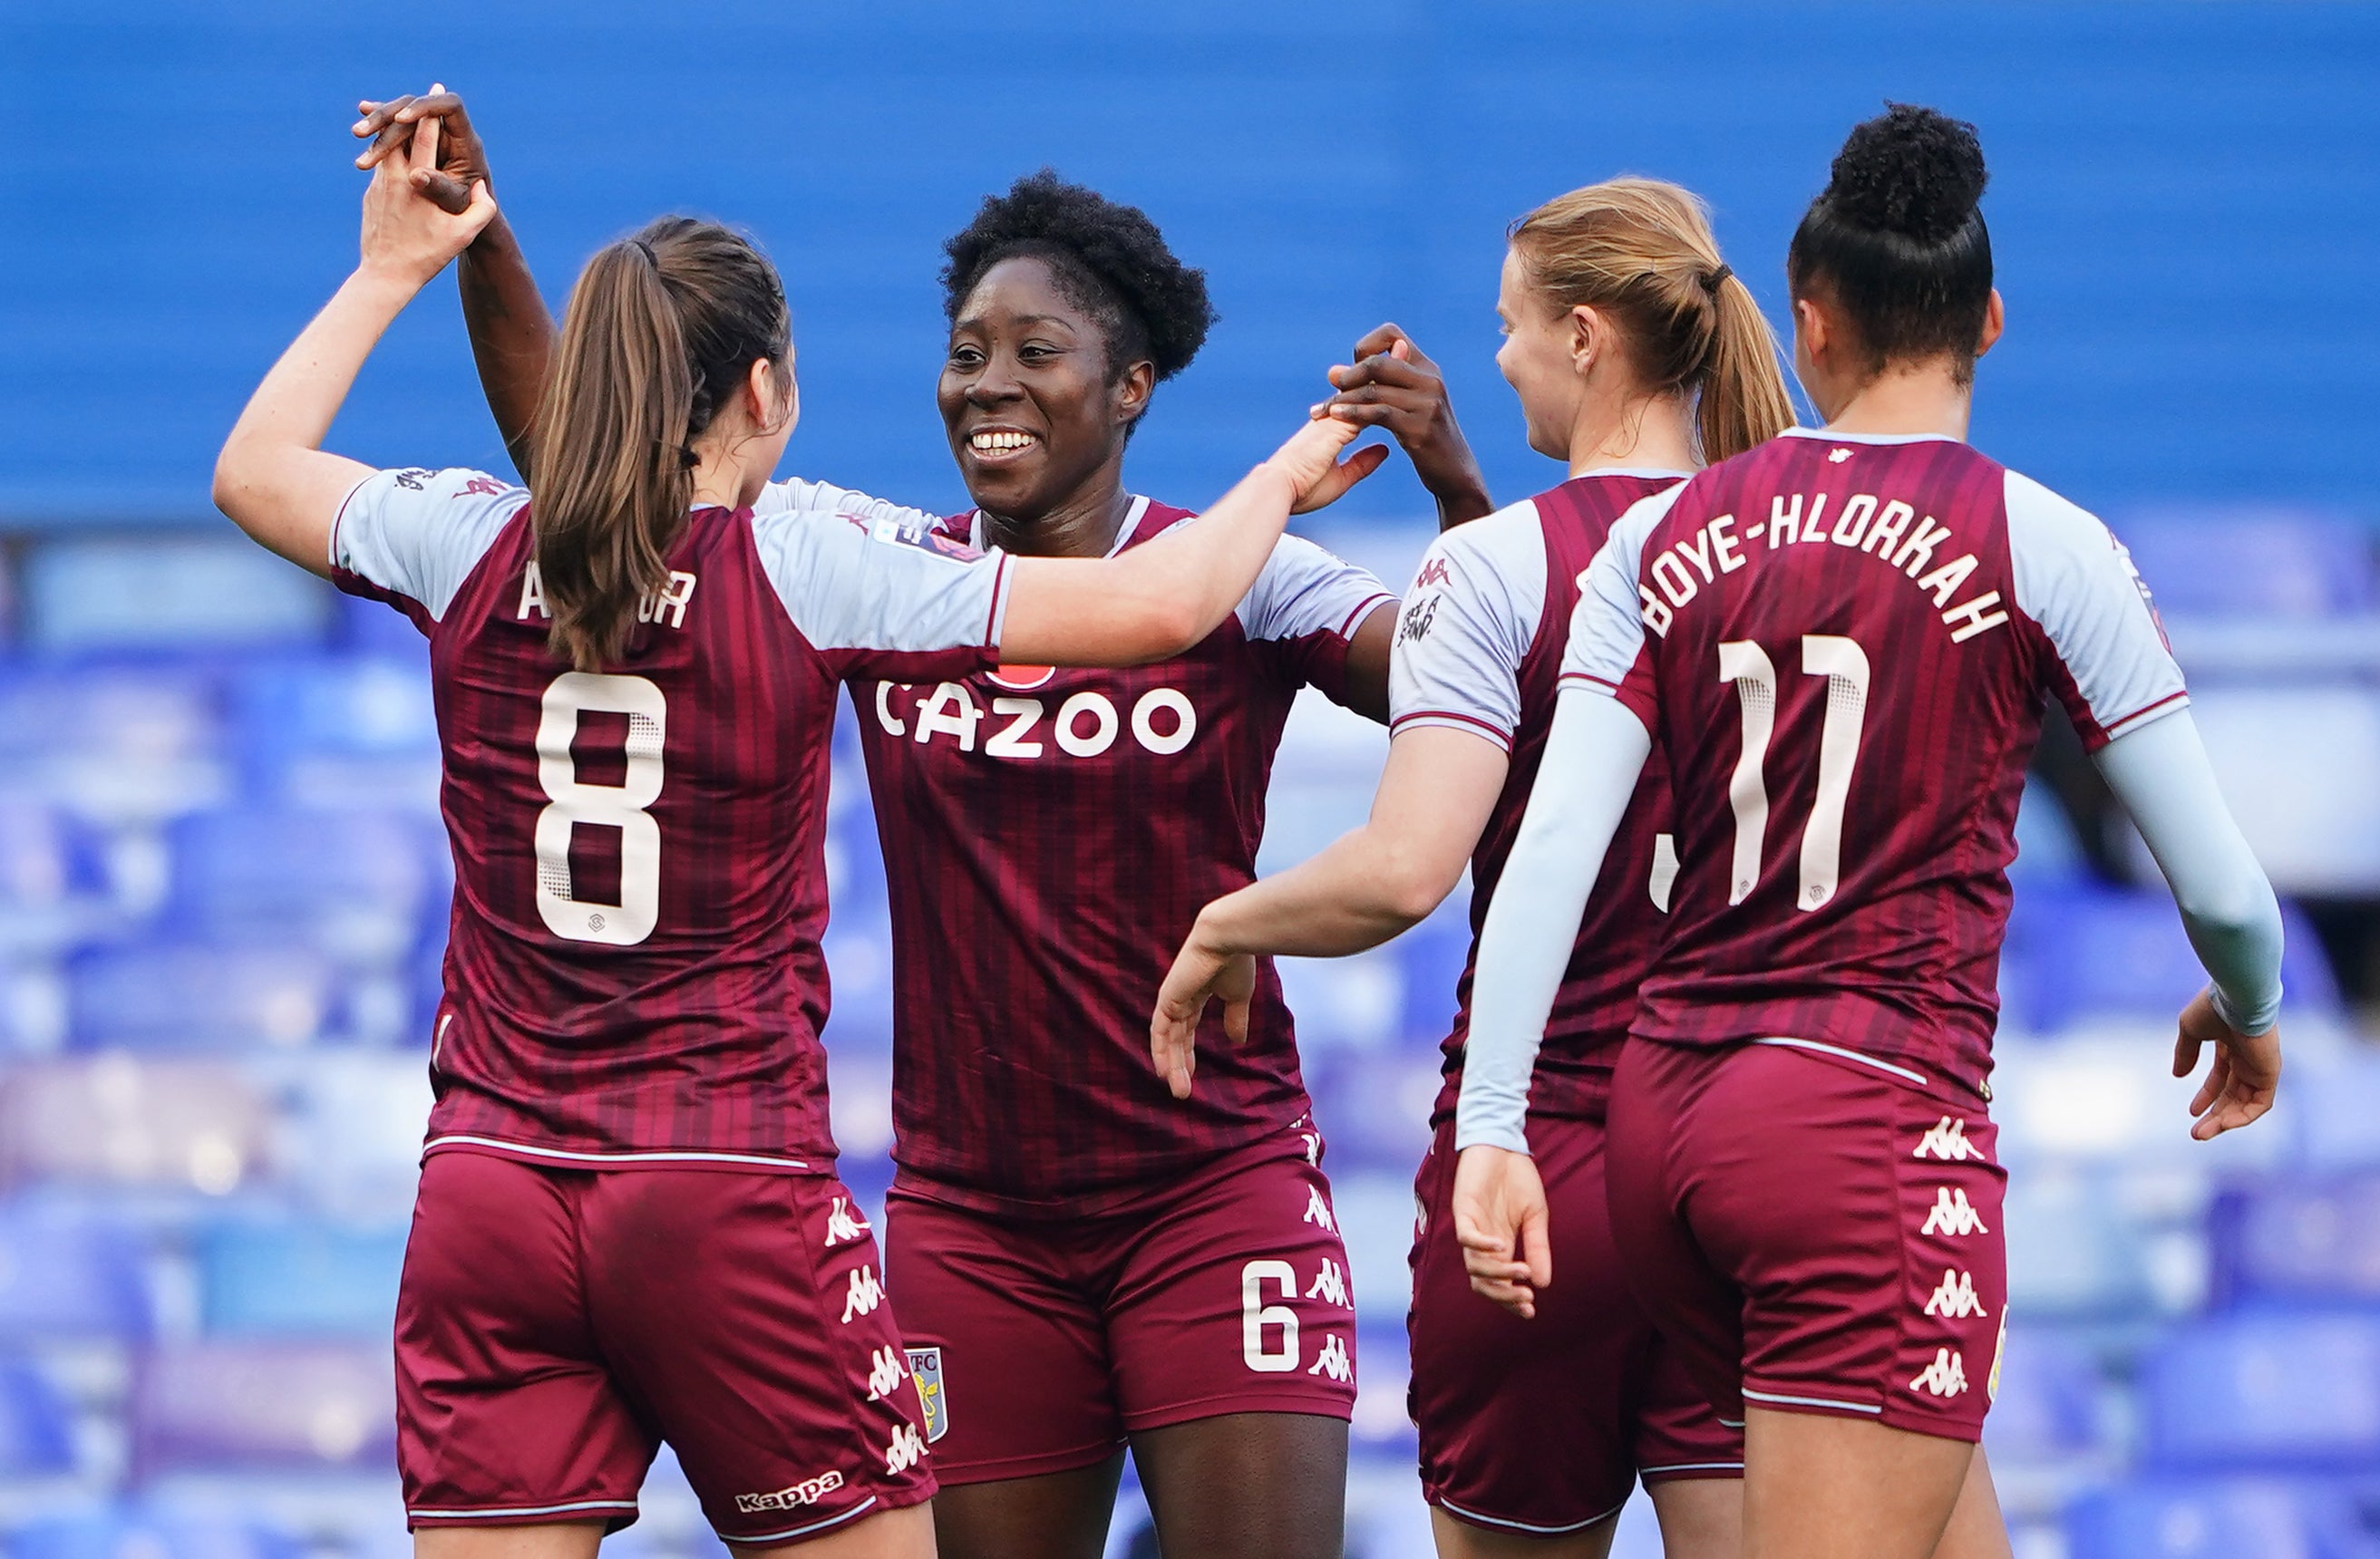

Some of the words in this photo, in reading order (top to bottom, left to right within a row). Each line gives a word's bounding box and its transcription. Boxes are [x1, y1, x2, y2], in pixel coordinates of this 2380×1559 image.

[1638, 493, 2009, 644] BOYE-HLORKAH
[875, 680, 1198, 758] CAZOO
[1718, 634, 1870, 912] 11
[535, 672, 667, 946] 8
[1242, 1260, 1299, 1372] 6
[734, 1470, 844, 1513] Kappa
